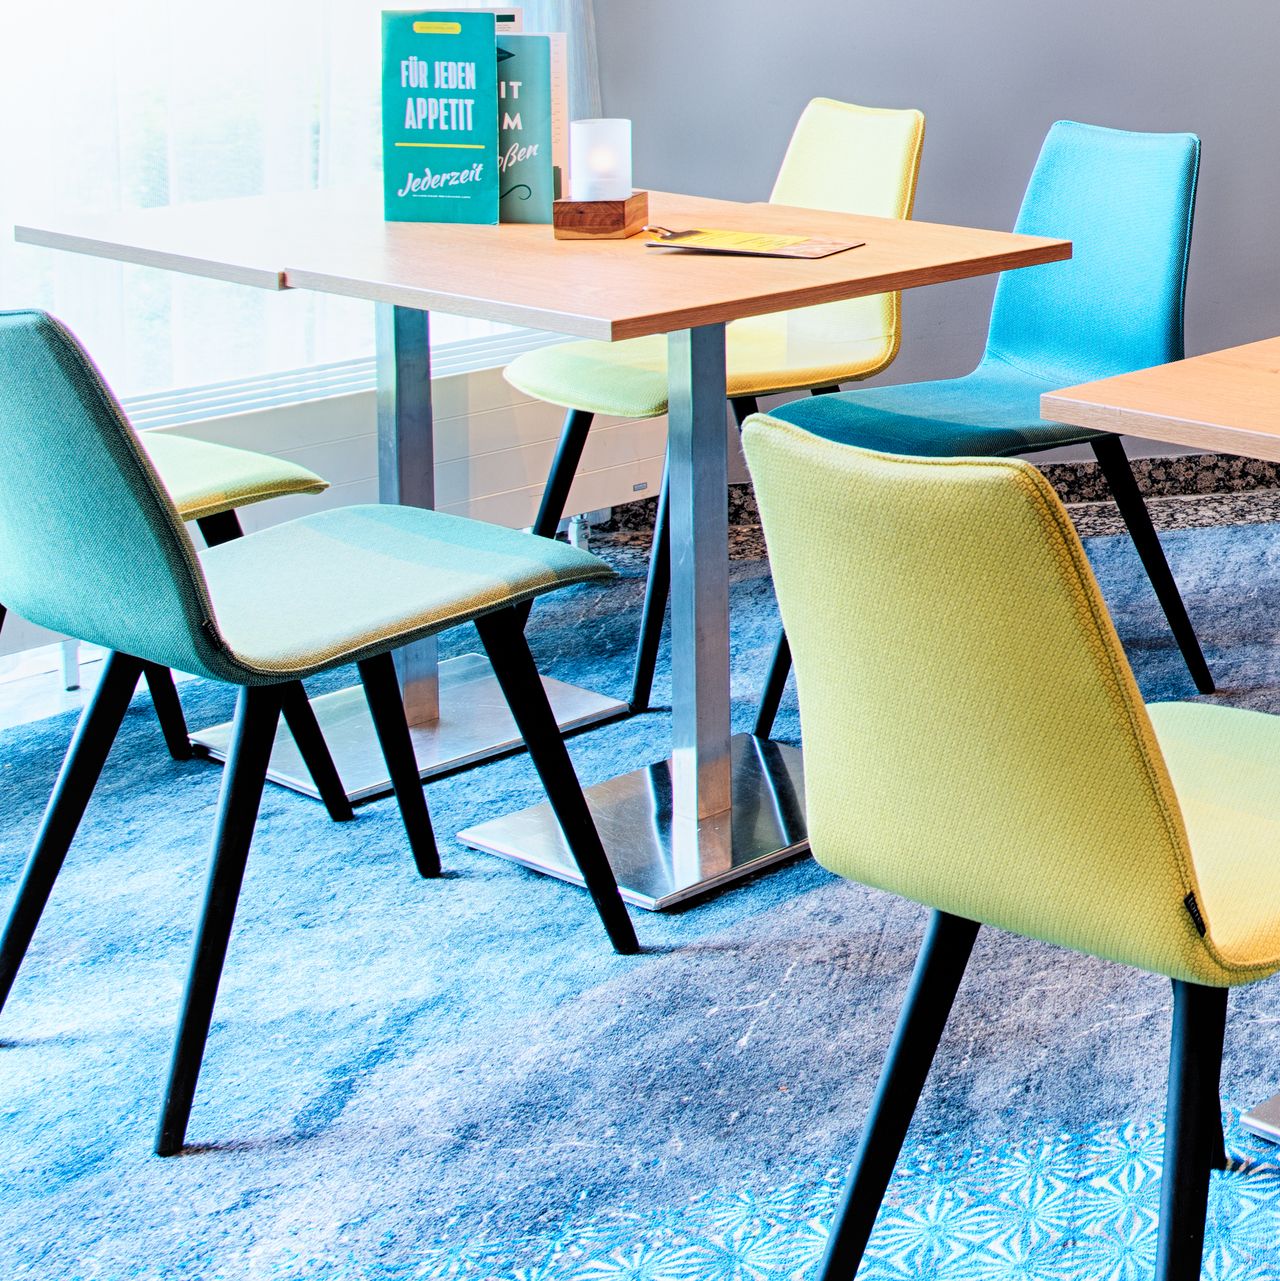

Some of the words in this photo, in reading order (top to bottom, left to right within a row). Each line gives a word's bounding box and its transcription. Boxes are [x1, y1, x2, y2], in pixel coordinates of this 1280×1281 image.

[401, 56, 429, 89] FÜR
[434, 61, 476, 90] JEDEN
[404, 97, 475, 132] APPETIT
[397, 162, 484, 198] Jederzeit
